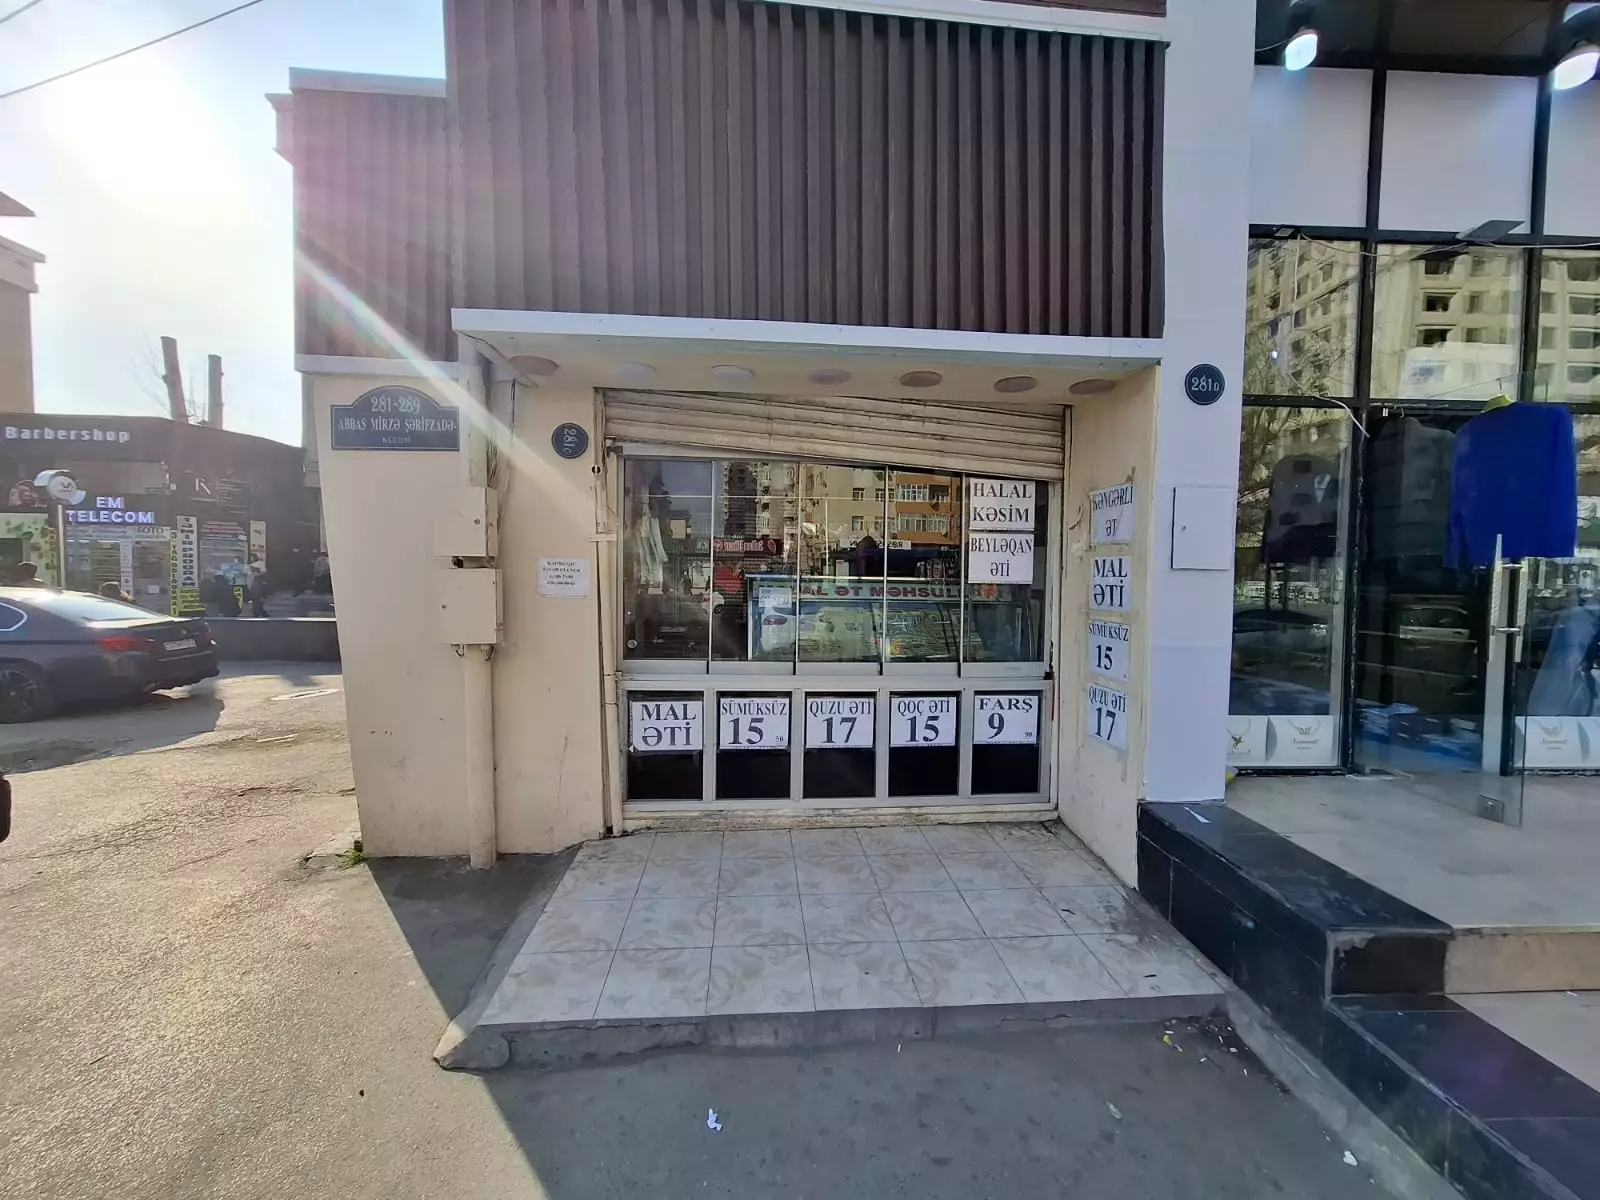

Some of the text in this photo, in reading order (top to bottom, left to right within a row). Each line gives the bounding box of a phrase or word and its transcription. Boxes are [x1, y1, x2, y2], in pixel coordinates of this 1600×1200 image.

[371, 395, 420, 414] 281-289
[339, 417, 367, 432] ABBAS
[371, 416, 400, 432] MİRZƏ
[4, 426, 131, 444] Barbershop
[973, 483, 1033, 499] HALAL
[96, 496, 125, 509] EM
[66, 510, 155, 524] TELECOM
[972, 504, 1030, 523] KƏSİM
[1105, 518, 1118, 537] ƏT
[971, 537, 1033, 556] BEYLƏQAN
[990, 560, 1011, 577] ƏTİ
[1093, 558, 1128, 578] MAL
[1093, 579, 1125, 607] ƏTİ
[1088, 621, 1129, 642] SÜMÜKSÜZ
[1096, 644, 1113, 670] 15
[721, 700, 787, 716] SÜMÜKSÜZ
[809, 698, 872, 718] QUZU ƏTİ
[897, 697, 950, 717] QOÇ ƏTİ
[978, 697, 1033, 714] FARŞ
[1088, 685, 1126, 713] QUZU ƏTİ
[640, 703, 697, 721] MAL
[727, 717, 784, 745] 15 50
[821, 716, 858, 744] 17
[905, 715, 940, 743] 15
[987, 712, 1033, 740] 9 90
[1094, 706, 1117, 741] 17
[641, 722, 693, 747] ƏTİ
